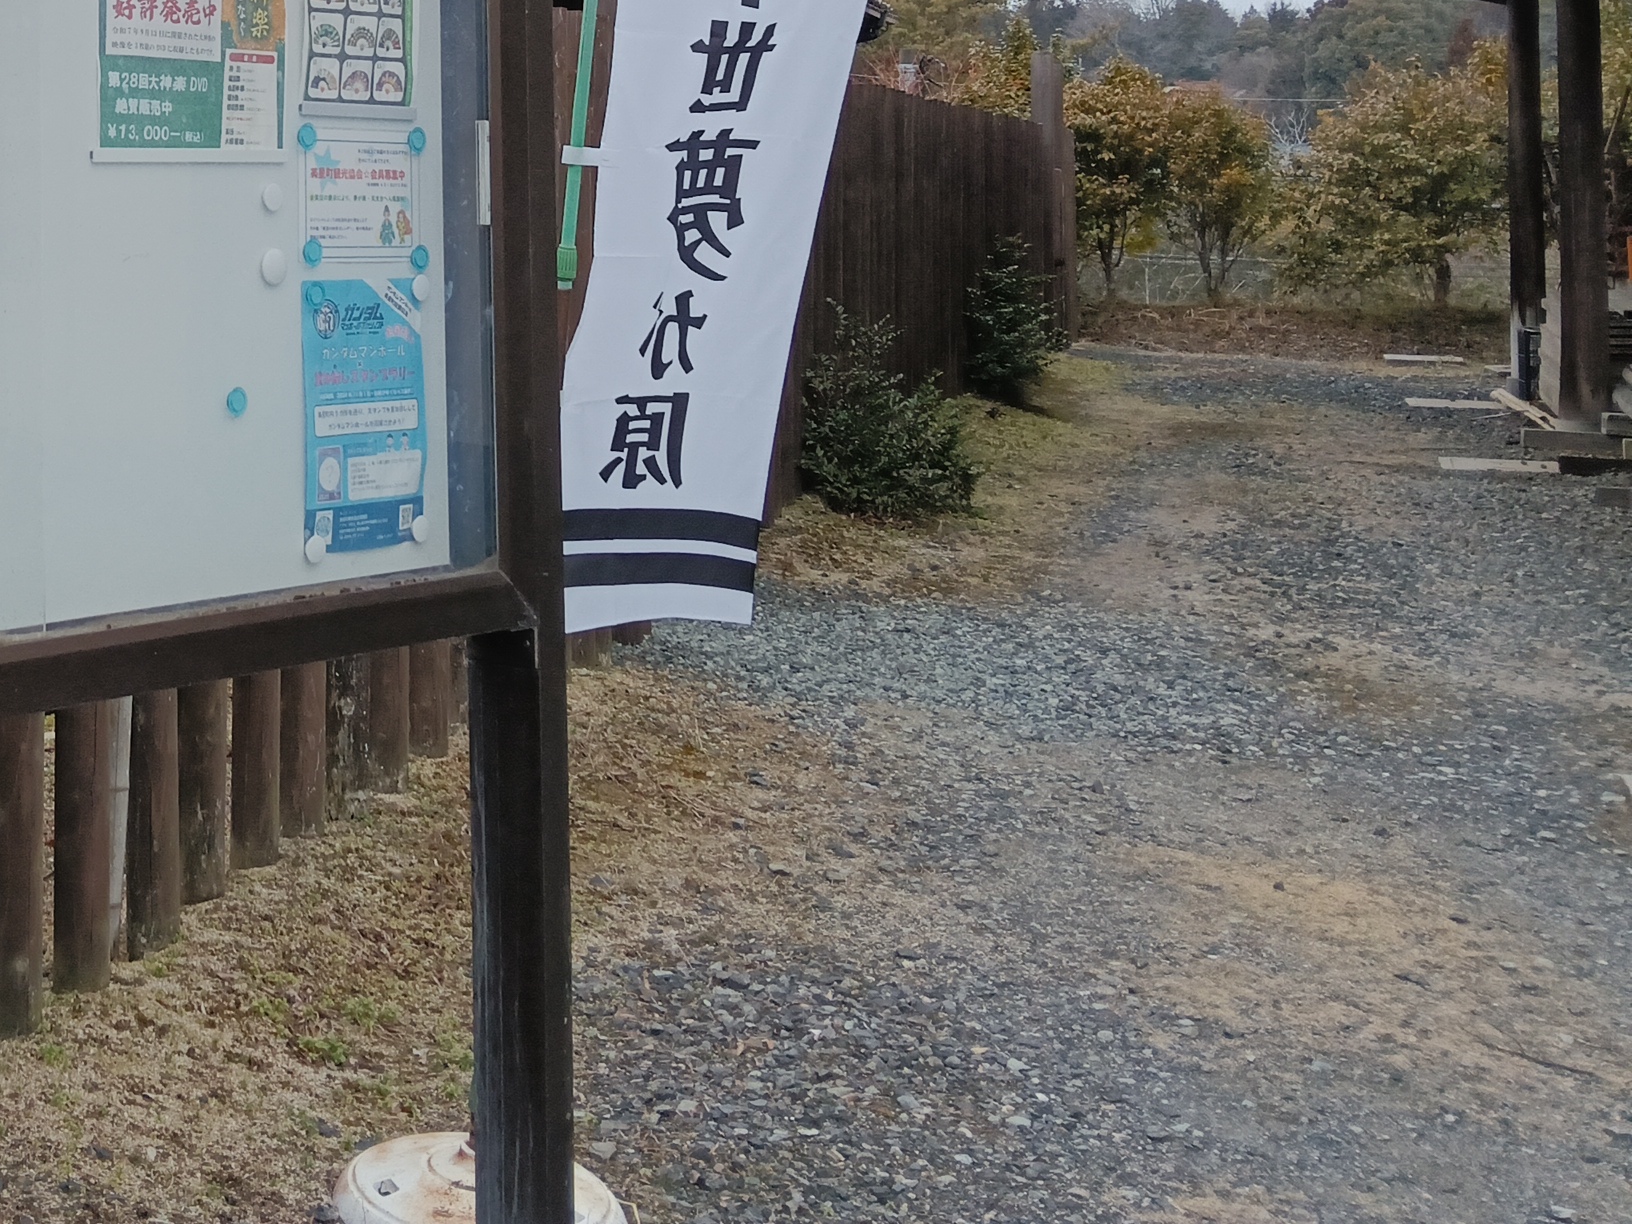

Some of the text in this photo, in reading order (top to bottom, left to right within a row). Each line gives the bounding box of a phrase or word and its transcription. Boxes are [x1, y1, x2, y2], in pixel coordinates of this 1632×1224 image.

[190, 77, 208, 92] DVD
[341, 302, 384, 322] ガンダム
[322, 345, 405, 359] ガンダムマンホール
